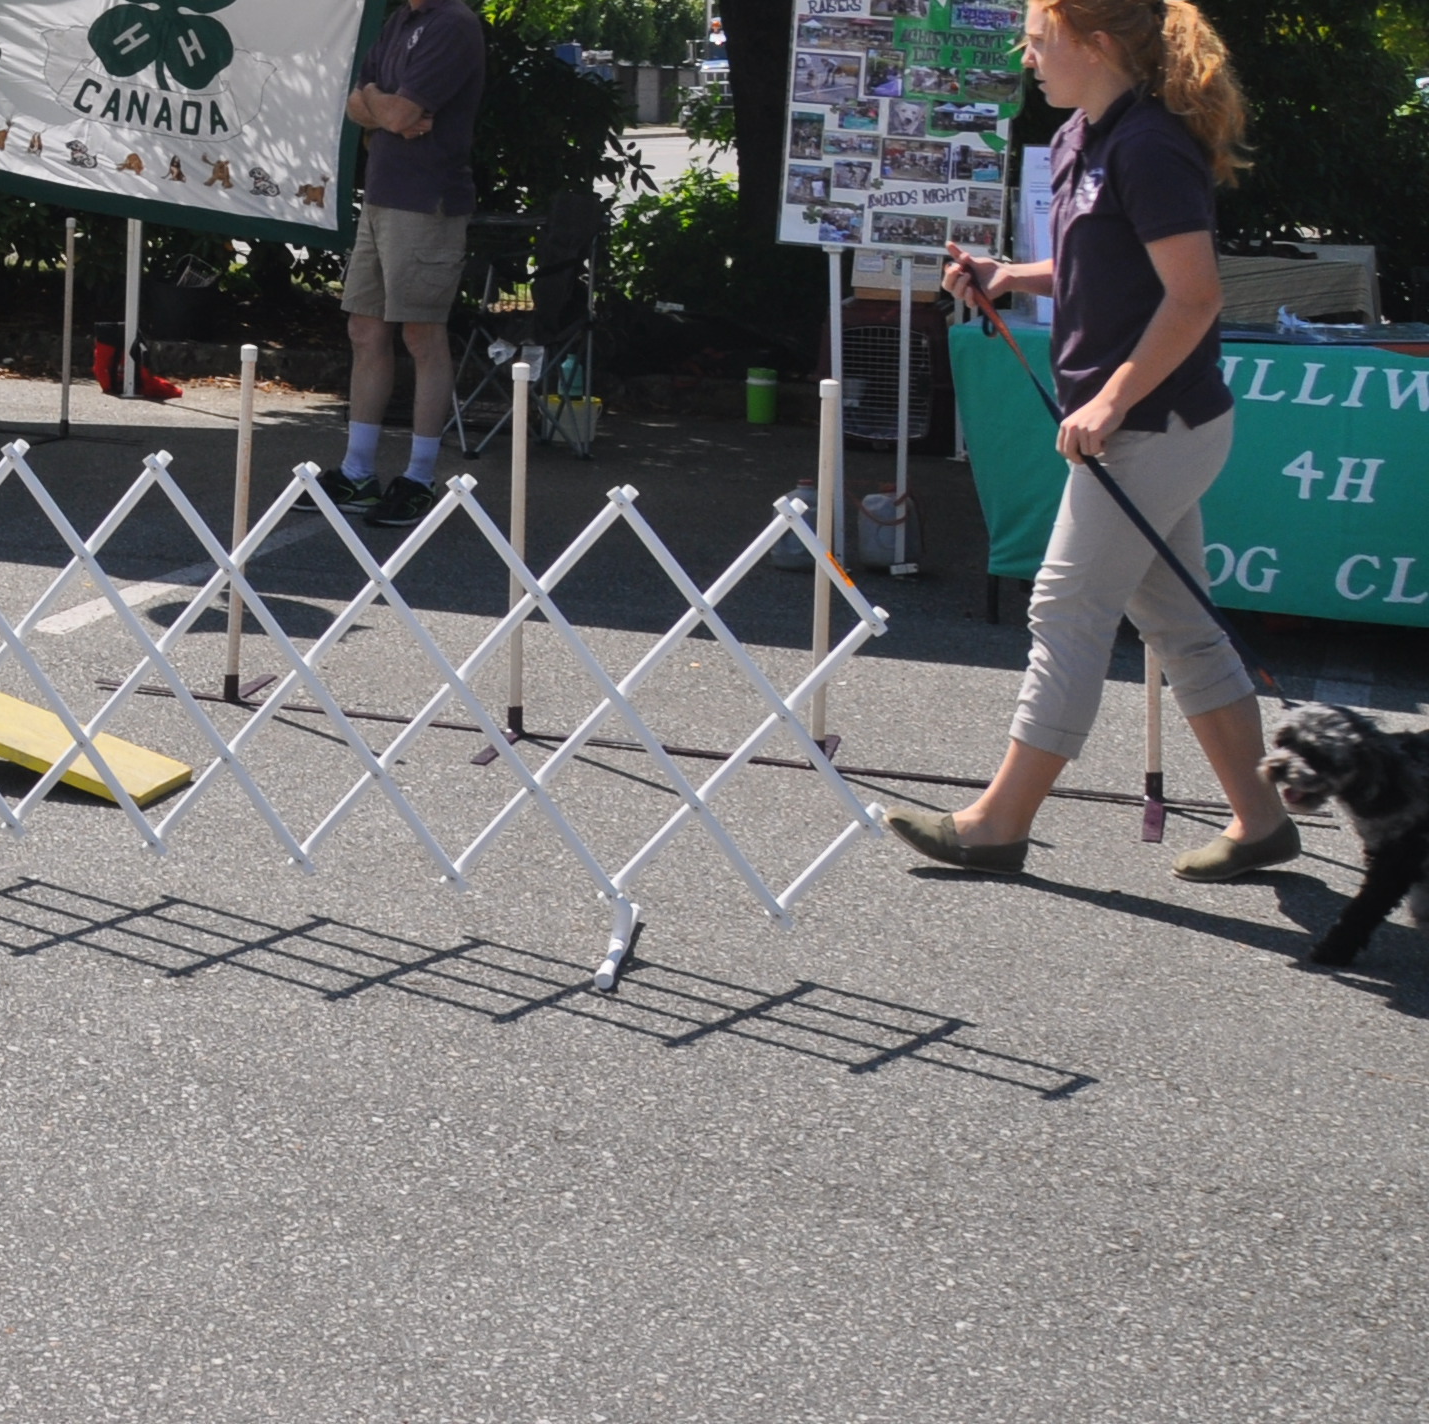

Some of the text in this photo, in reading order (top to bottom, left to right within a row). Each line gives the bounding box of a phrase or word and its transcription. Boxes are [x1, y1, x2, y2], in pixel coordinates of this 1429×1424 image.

[950, 49, 963, 63] &
[73, 77, 229, 136] CANADA
[867, 189, 919, 209] AWARDS
[1281, 450, 1386, 503] 4H
